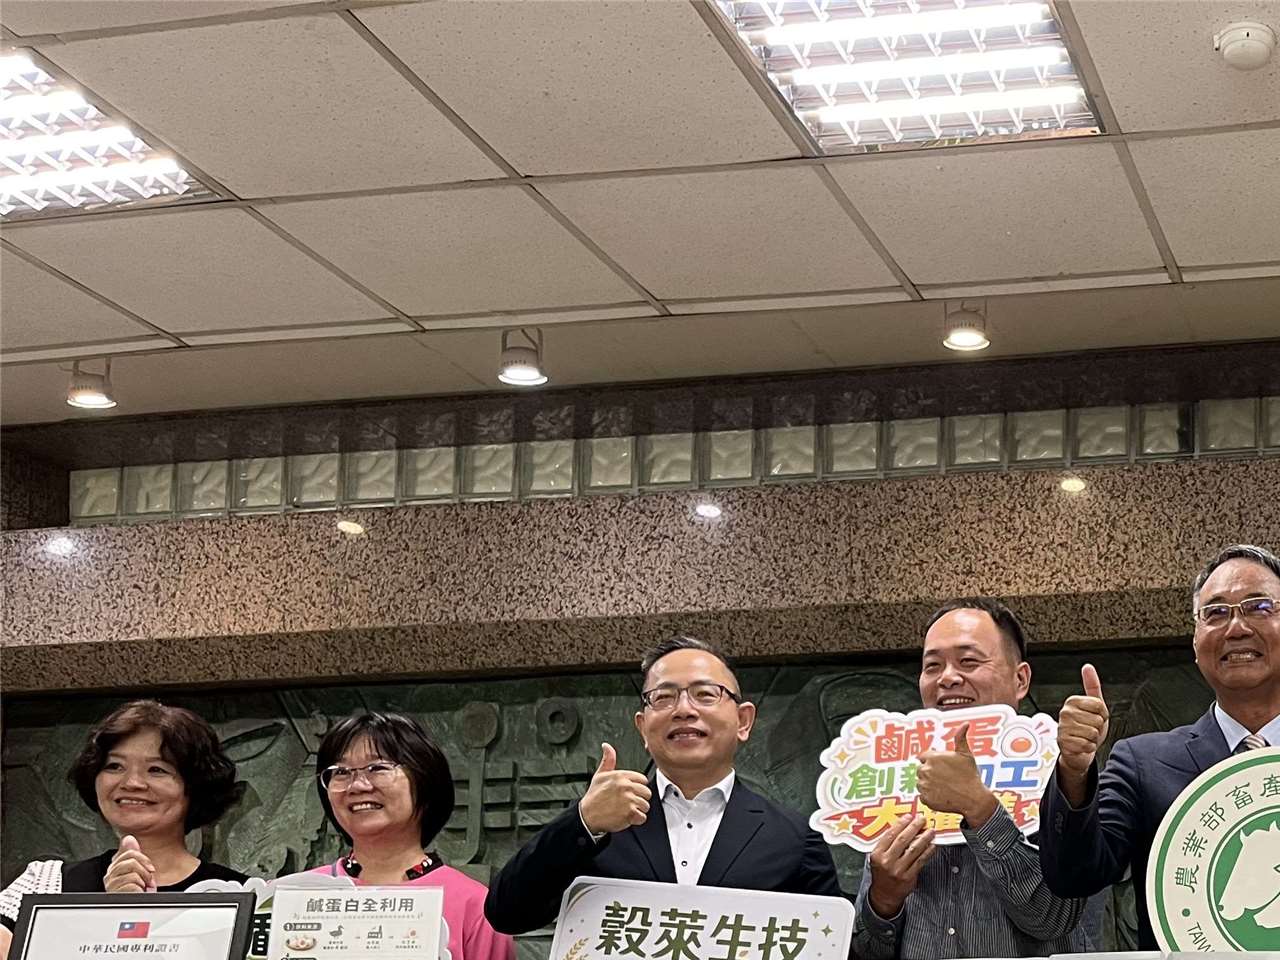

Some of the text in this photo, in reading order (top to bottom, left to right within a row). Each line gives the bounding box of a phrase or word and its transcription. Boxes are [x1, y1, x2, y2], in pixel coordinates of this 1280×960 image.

[306, 898, 414, 913] 鹹蛋白全利用
